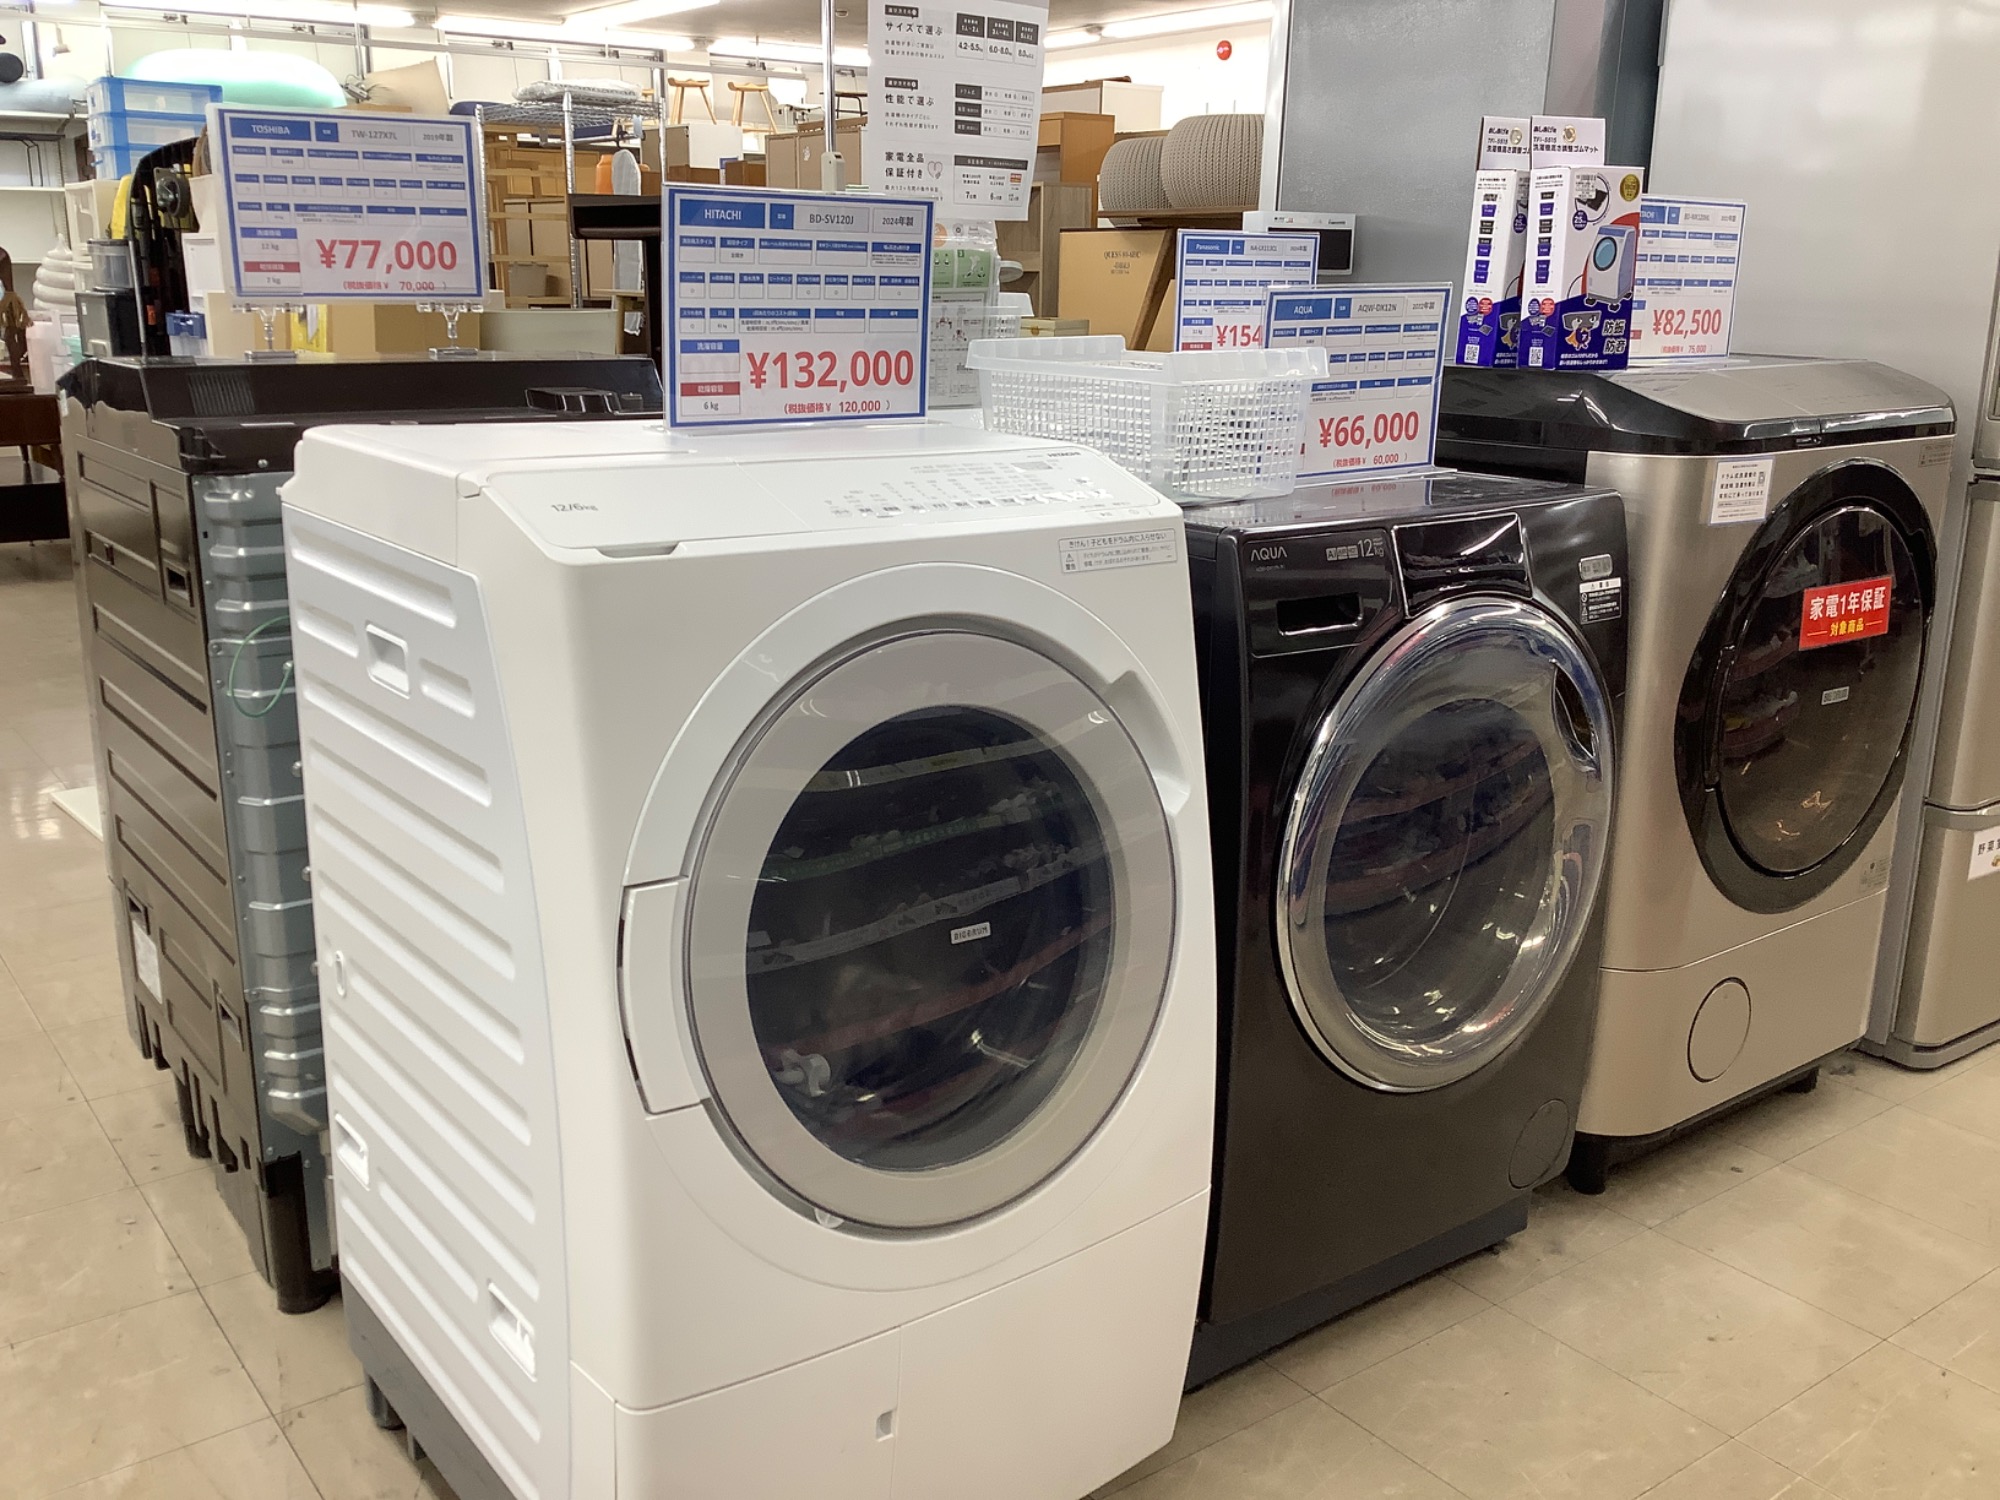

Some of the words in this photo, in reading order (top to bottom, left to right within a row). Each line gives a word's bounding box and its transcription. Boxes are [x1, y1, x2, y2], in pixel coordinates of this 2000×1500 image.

[885, 22, 943, 36] サイズで選ぶ
[885, 94, 935, 107] 性能で選ぶ
[251, 124, 291, 135] TOSHIBA
[885, 152, 925, 164] 家電全品
[885, 167, 924, 179] 保証付き
[704, 208, 742, 220] HITACHI
[809, 213, 855, 225] BD-SV120J
[882, 216, 915, 227] 2024年製
[1196, 243, 1220, 252] Panasonic
[316, 238, 458, 274] ¥77,000
[1293, 305, 1313, 314] AQUA
[1653, 309, 1722, 339] ¥82,500
[746, 350, 914, 393] ¥132,000
[703, 402, 709, 410] 6
[710, 401, 719, 411] kg
[839, 400, 881, 414] 120,000
[1318, 411, 1419, 449] ¥66,000
[1250, 546, 1288, 561] AQUA
[1358, 538, 1374, 557] 12
[1809, 586, 1886, 620] 家電1年保証
[1830, 617, 1864, 636] 対象商品
